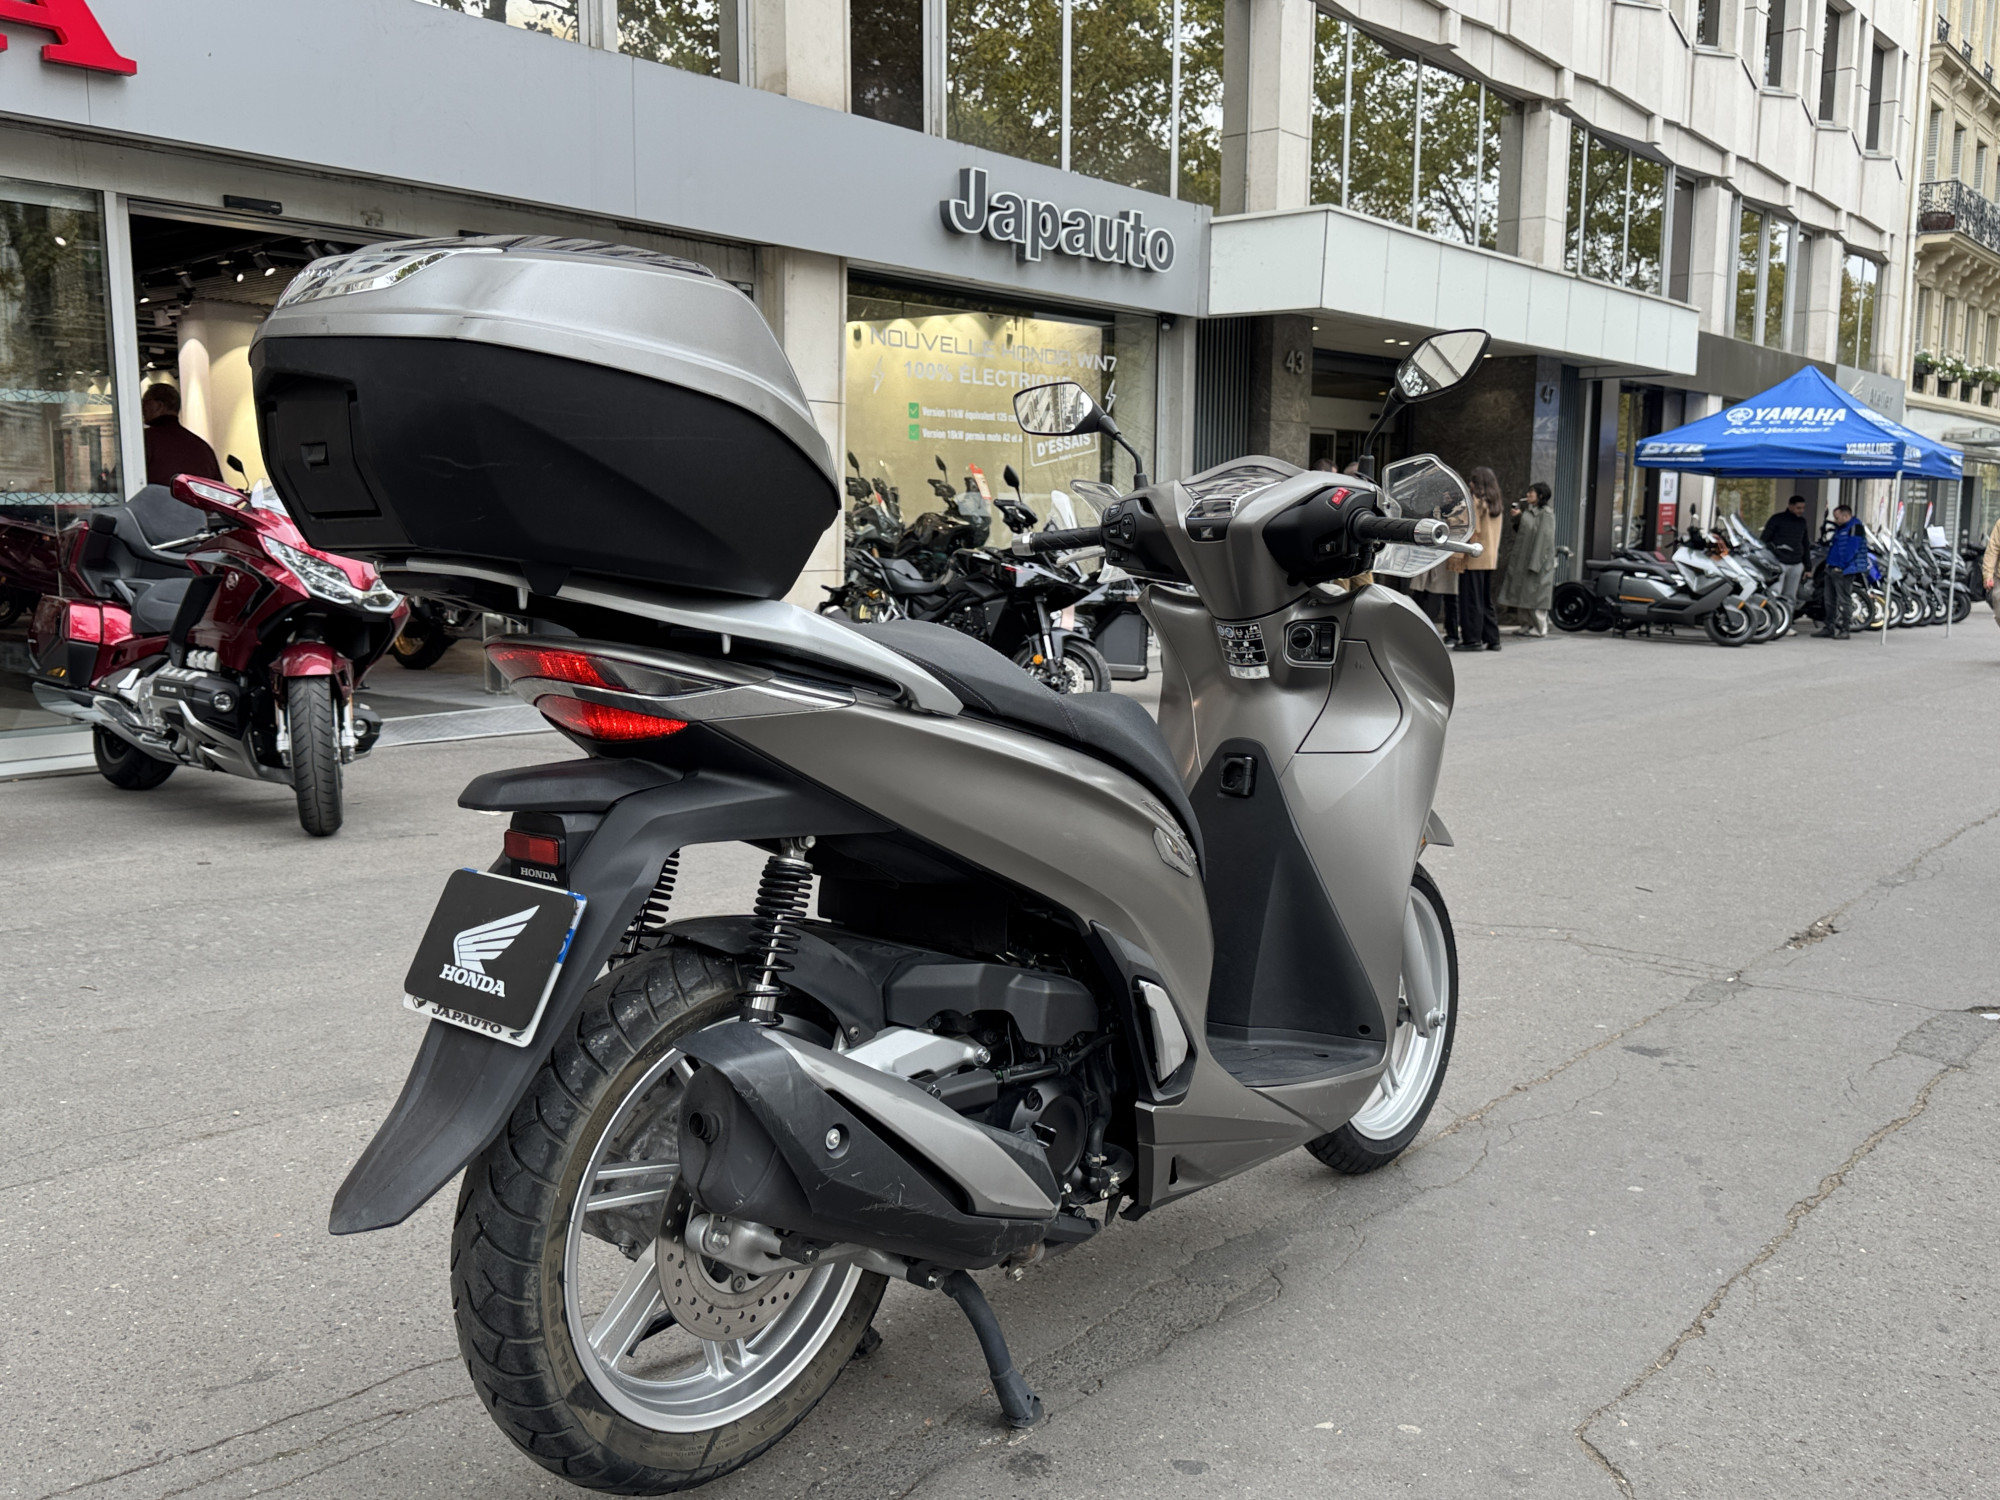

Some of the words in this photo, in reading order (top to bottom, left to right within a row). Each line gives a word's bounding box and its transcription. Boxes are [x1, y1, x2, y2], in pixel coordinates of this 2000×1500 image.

[948, 167, 1176, 273] Japauto
[871, 327, 995, 359] NOUVELLE
[1077, 353, 1117, 372] WN7
[904, 361, 954, 382] 100%
[1286, 350, 1304, 374] 43
[922, 406, 946, 418] Version
[1755, 406, 1847, 421] YAMAHA
[922, 428, 946, 439] Version
[1037, 433, 1091, 457] D'ESSAIS
[1846, 442, 1895, 455] YAMALUBE
[520, 867, 558, 882] HONDA
[439, 963, 505, 997] HONDA
[432, 1005, 502, 1034] JAPAUTO
